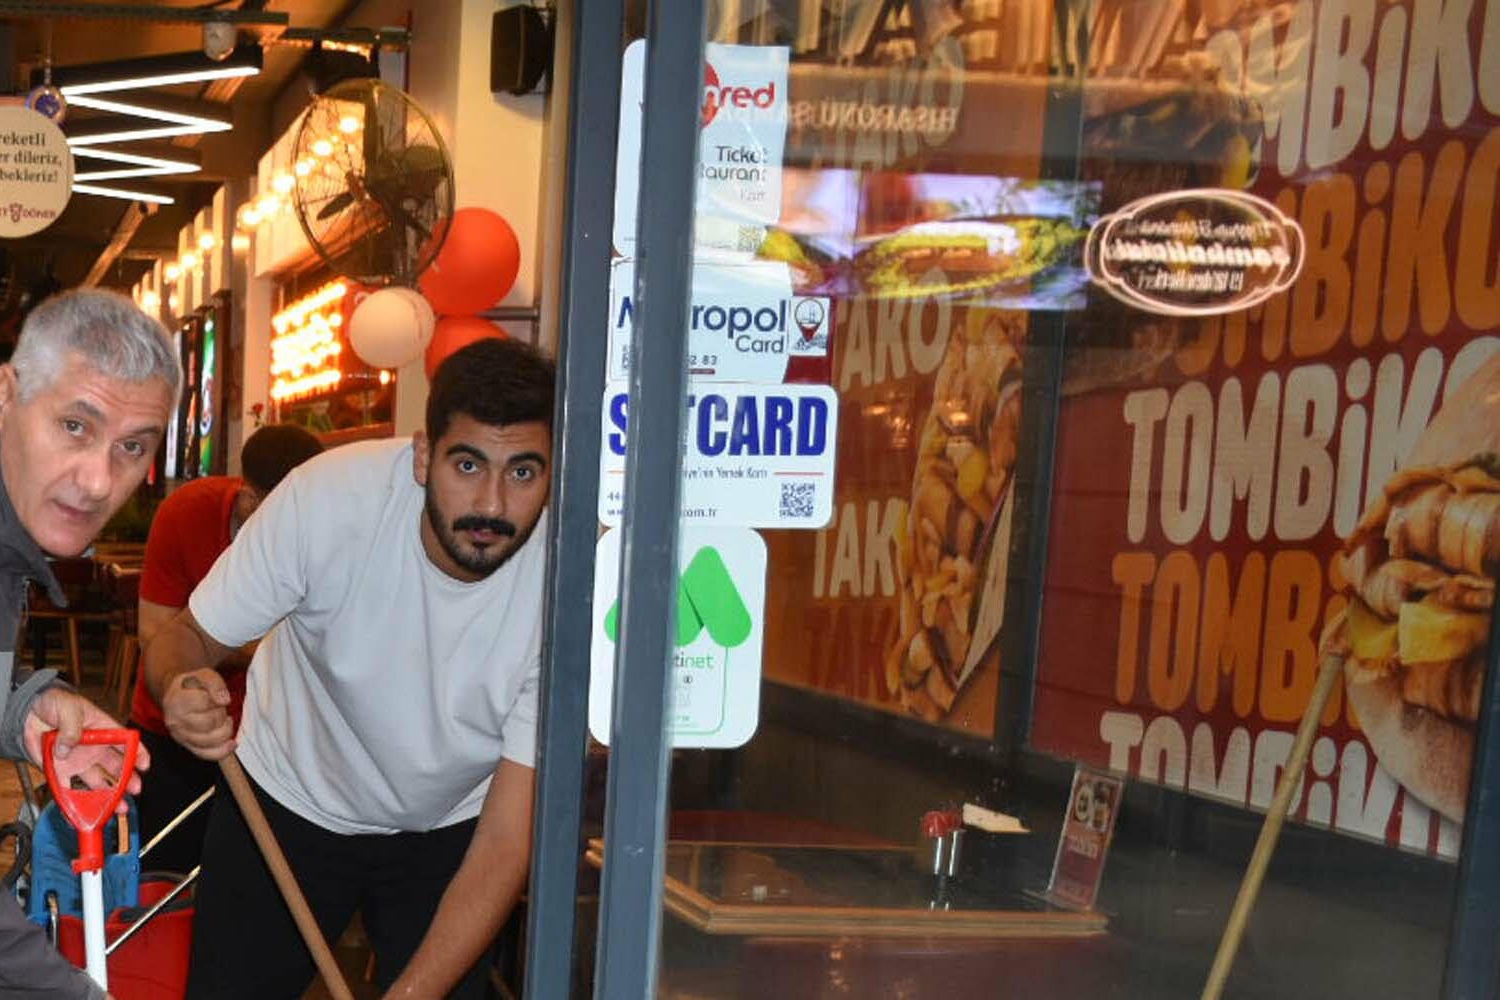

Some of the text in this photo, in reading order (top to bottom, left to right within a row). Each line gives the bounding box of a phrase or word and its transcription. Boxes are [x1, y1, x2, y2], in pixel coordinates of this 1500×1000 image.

[14, 151, 62, 167] dileriz,
[0, 168, 58, 184] bekleriz!
[23, 208, 56, 219] DÖNER
[735, 335, 785, 354] Card
[703, 354, 718, 366] 83
[608, 392, 829, 457] SCARD
[1124, 337, 1498, 545] TOMBiK
